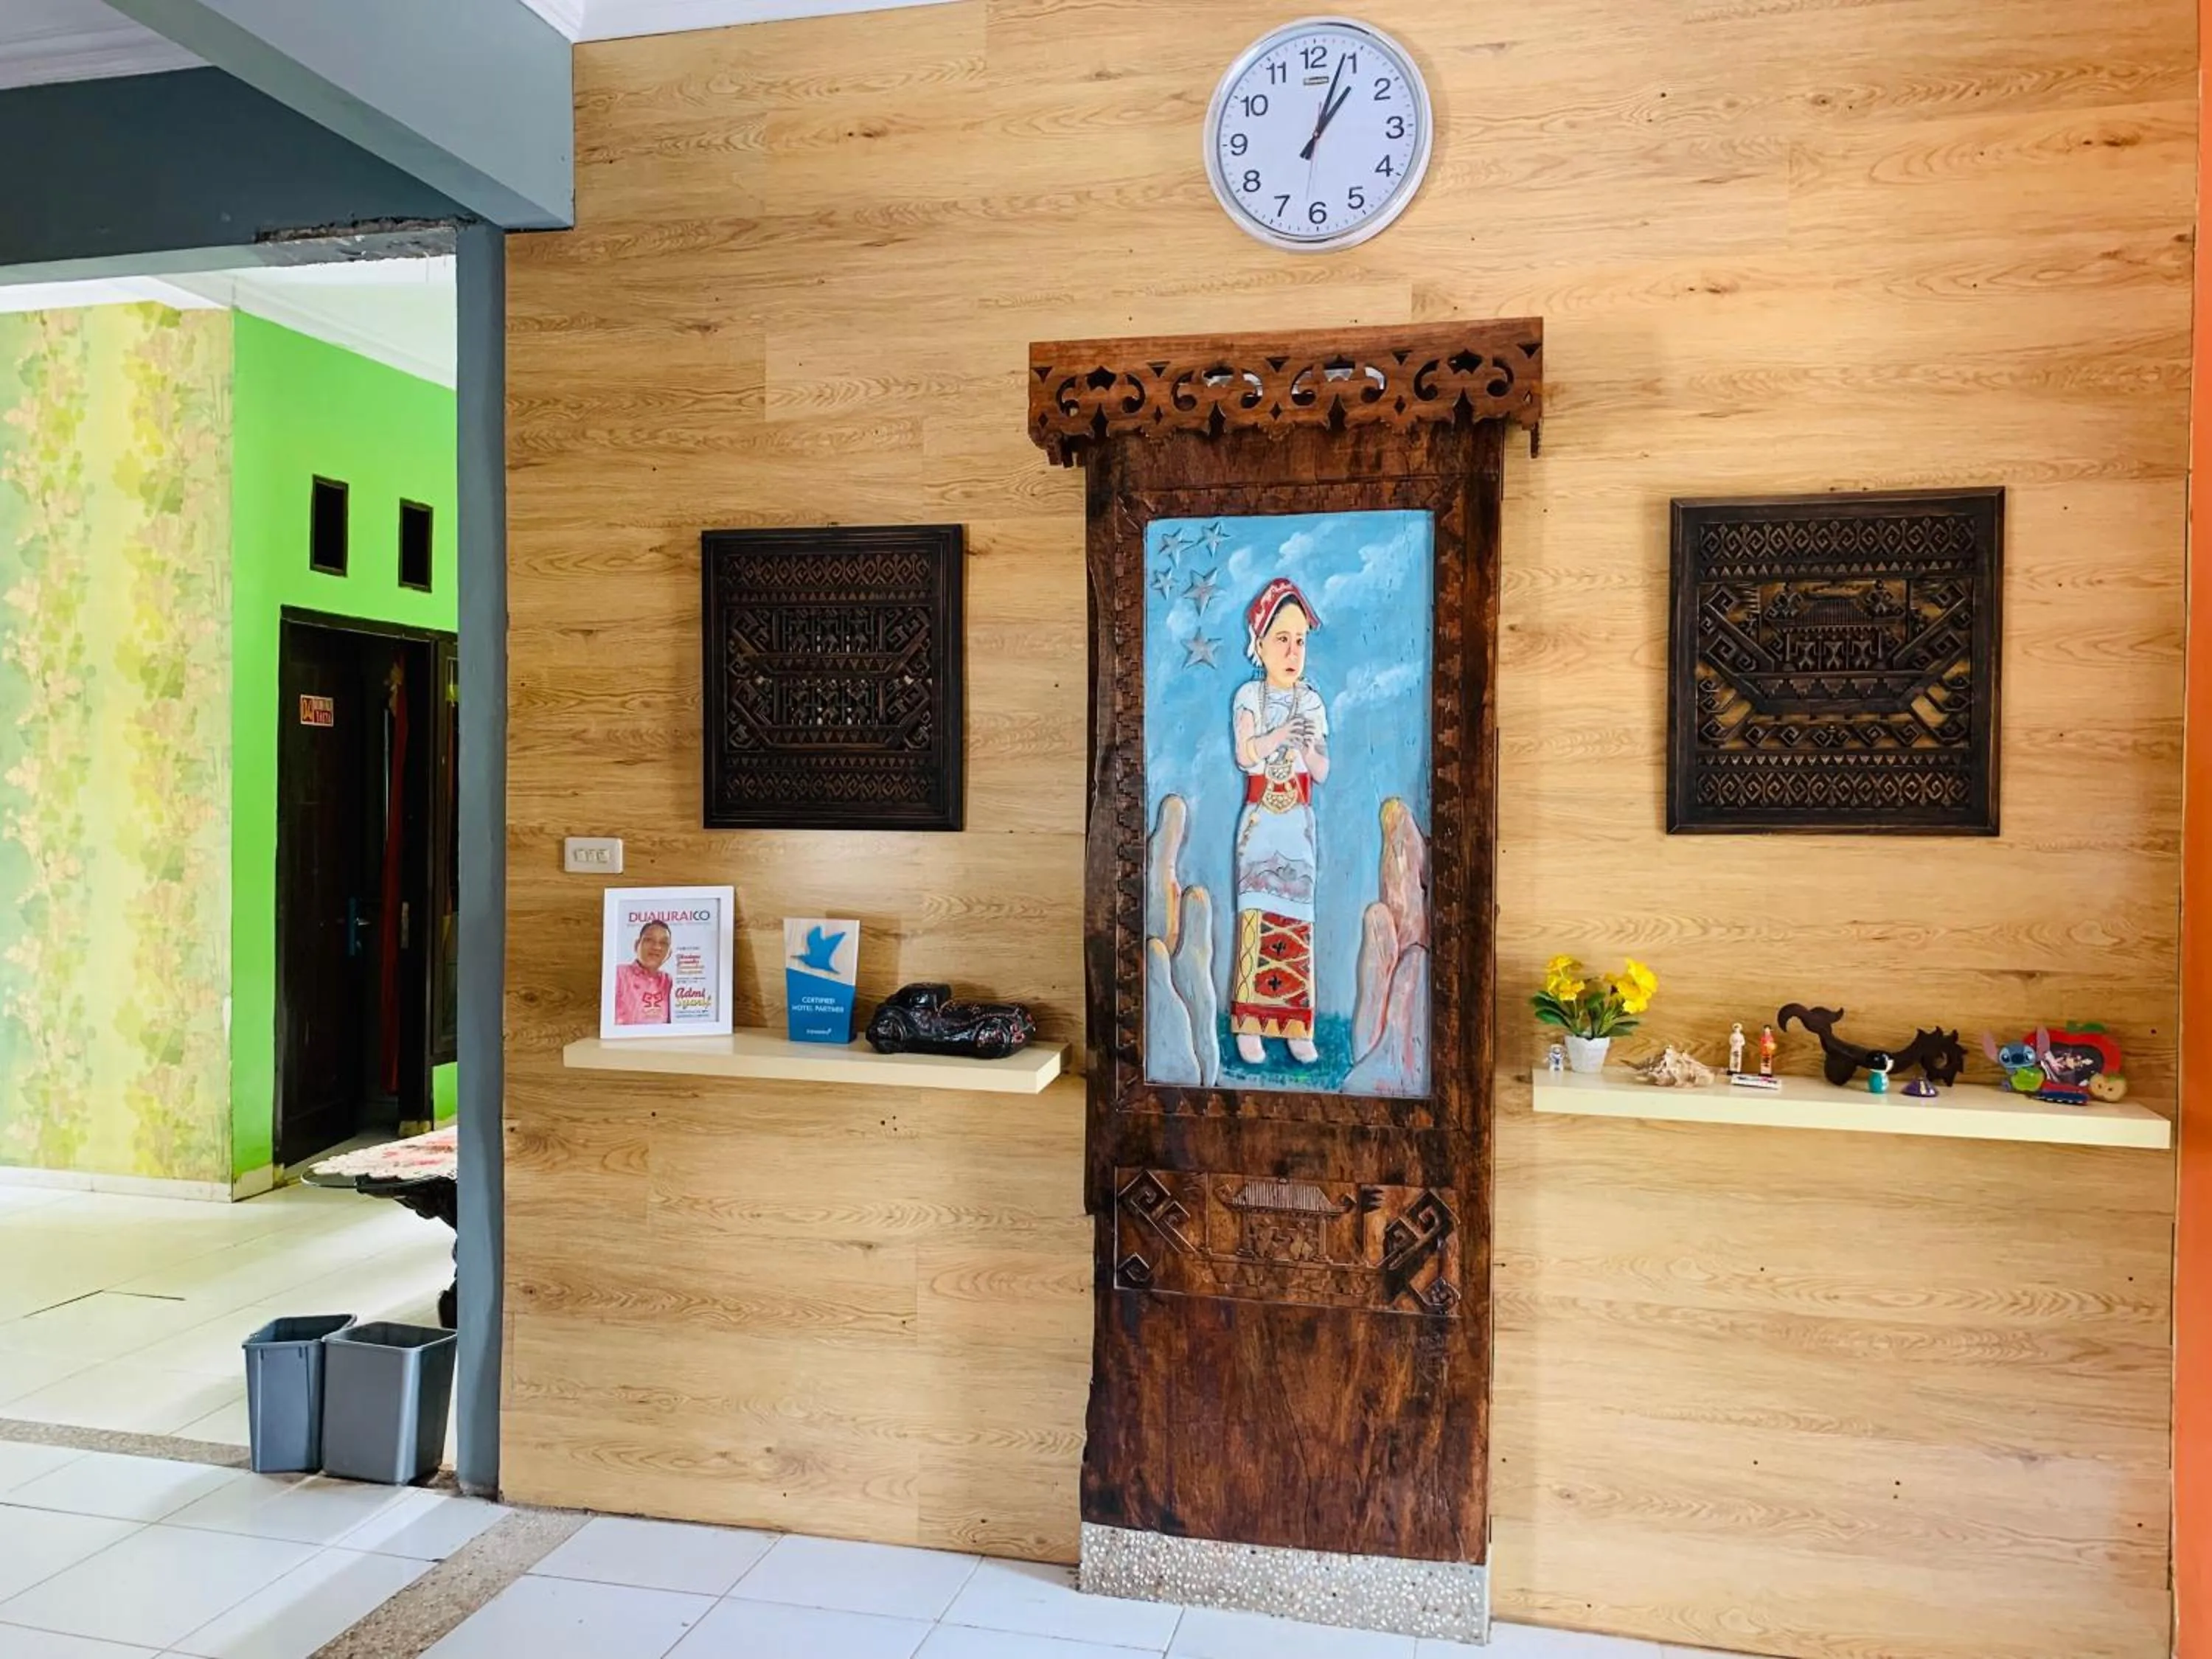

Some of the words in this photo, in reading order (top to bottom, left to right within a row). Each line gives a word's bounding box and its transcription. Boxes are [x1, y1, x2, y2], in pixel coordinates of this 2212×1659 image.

[1299, 46, 1328, 70] 12
[1346, 52, 1357, 74] 1
[1265, 61, 1287, 85] 11
[1374, 77, 1391, 101] 2
[1239, 94, 1268, 117] 10
[1385, 116, 1405, 139] 3
[1230, 133, 1248, 156] 9
[1374, 154, 1394, 178] 4
[1242, 170, 1262, 192] 8
[1273, 194, 1291, 218] 7
[1347, 186, 1365, 209] 5
[1308, 201, 1327, 225] 6
[791, 1004, 813, 1012] HOTEL
[815, 1005, 844, 1013] PARTNER
